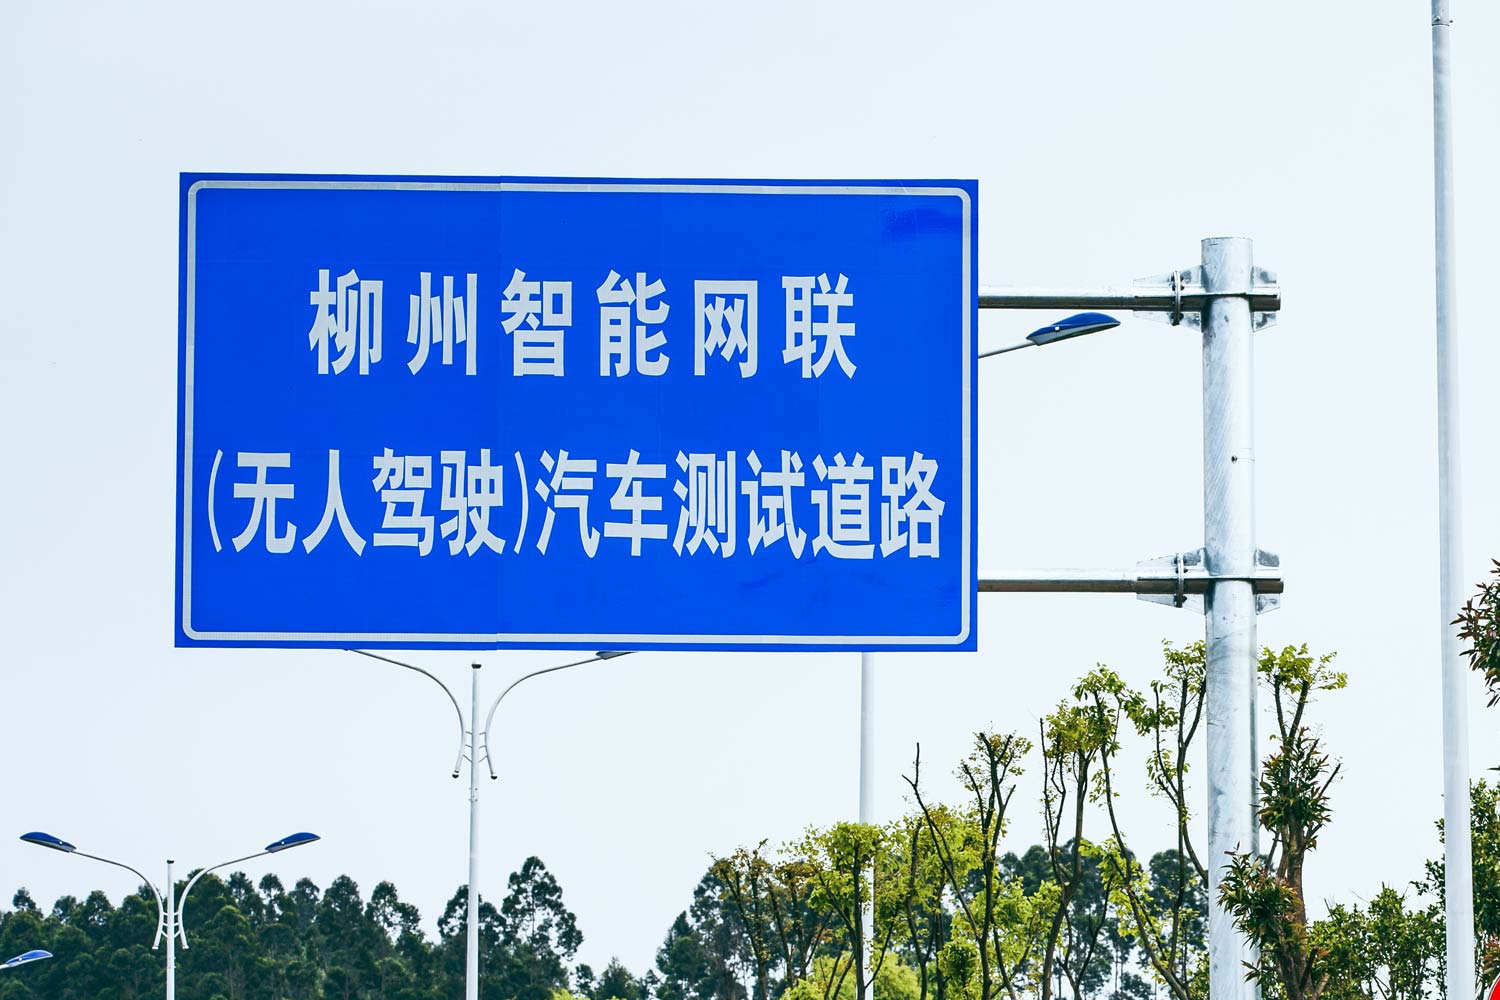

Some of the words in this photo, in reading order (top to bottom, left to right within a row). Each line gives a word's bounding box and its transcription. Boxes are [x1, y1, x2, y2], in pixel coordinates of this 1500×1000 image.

[308, 268, 857, 379] 柳州智能网联
[207, 447, 946, 560] (无人驾驶)汽车测试道路
